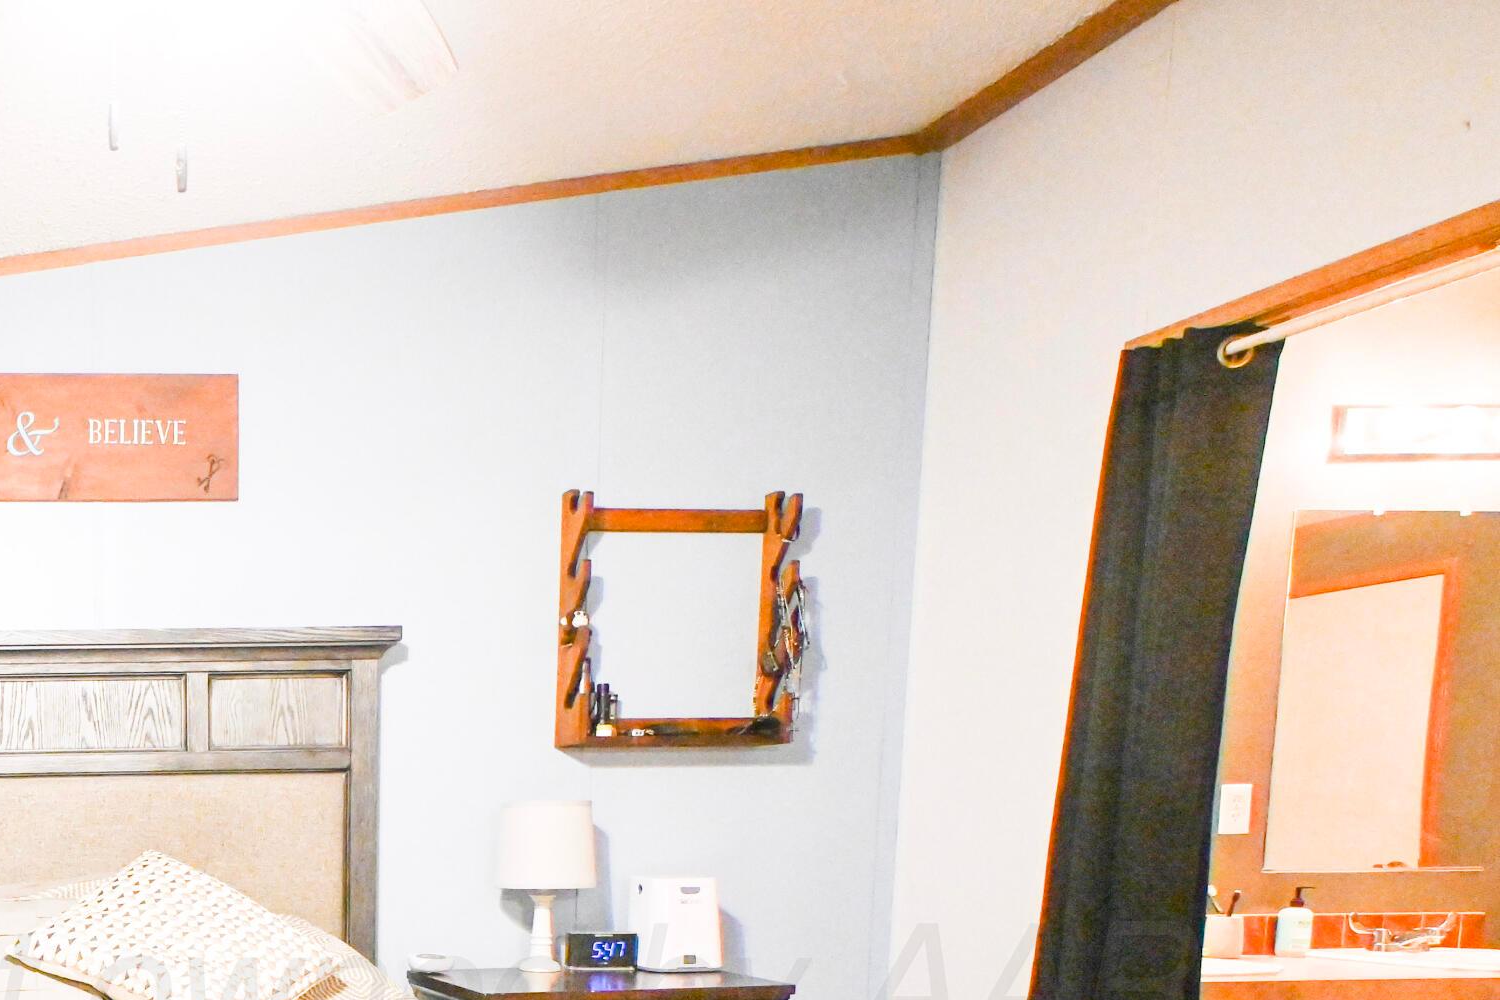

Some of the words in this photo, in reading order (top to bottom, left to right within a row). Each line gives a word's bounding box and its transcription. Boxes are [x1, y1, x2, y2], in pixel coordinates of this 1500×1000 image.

[6, 411, 60, 457] &
[87, 418, 187, 446] BELIEVE
[591, 941, 627, 959] 5:47
